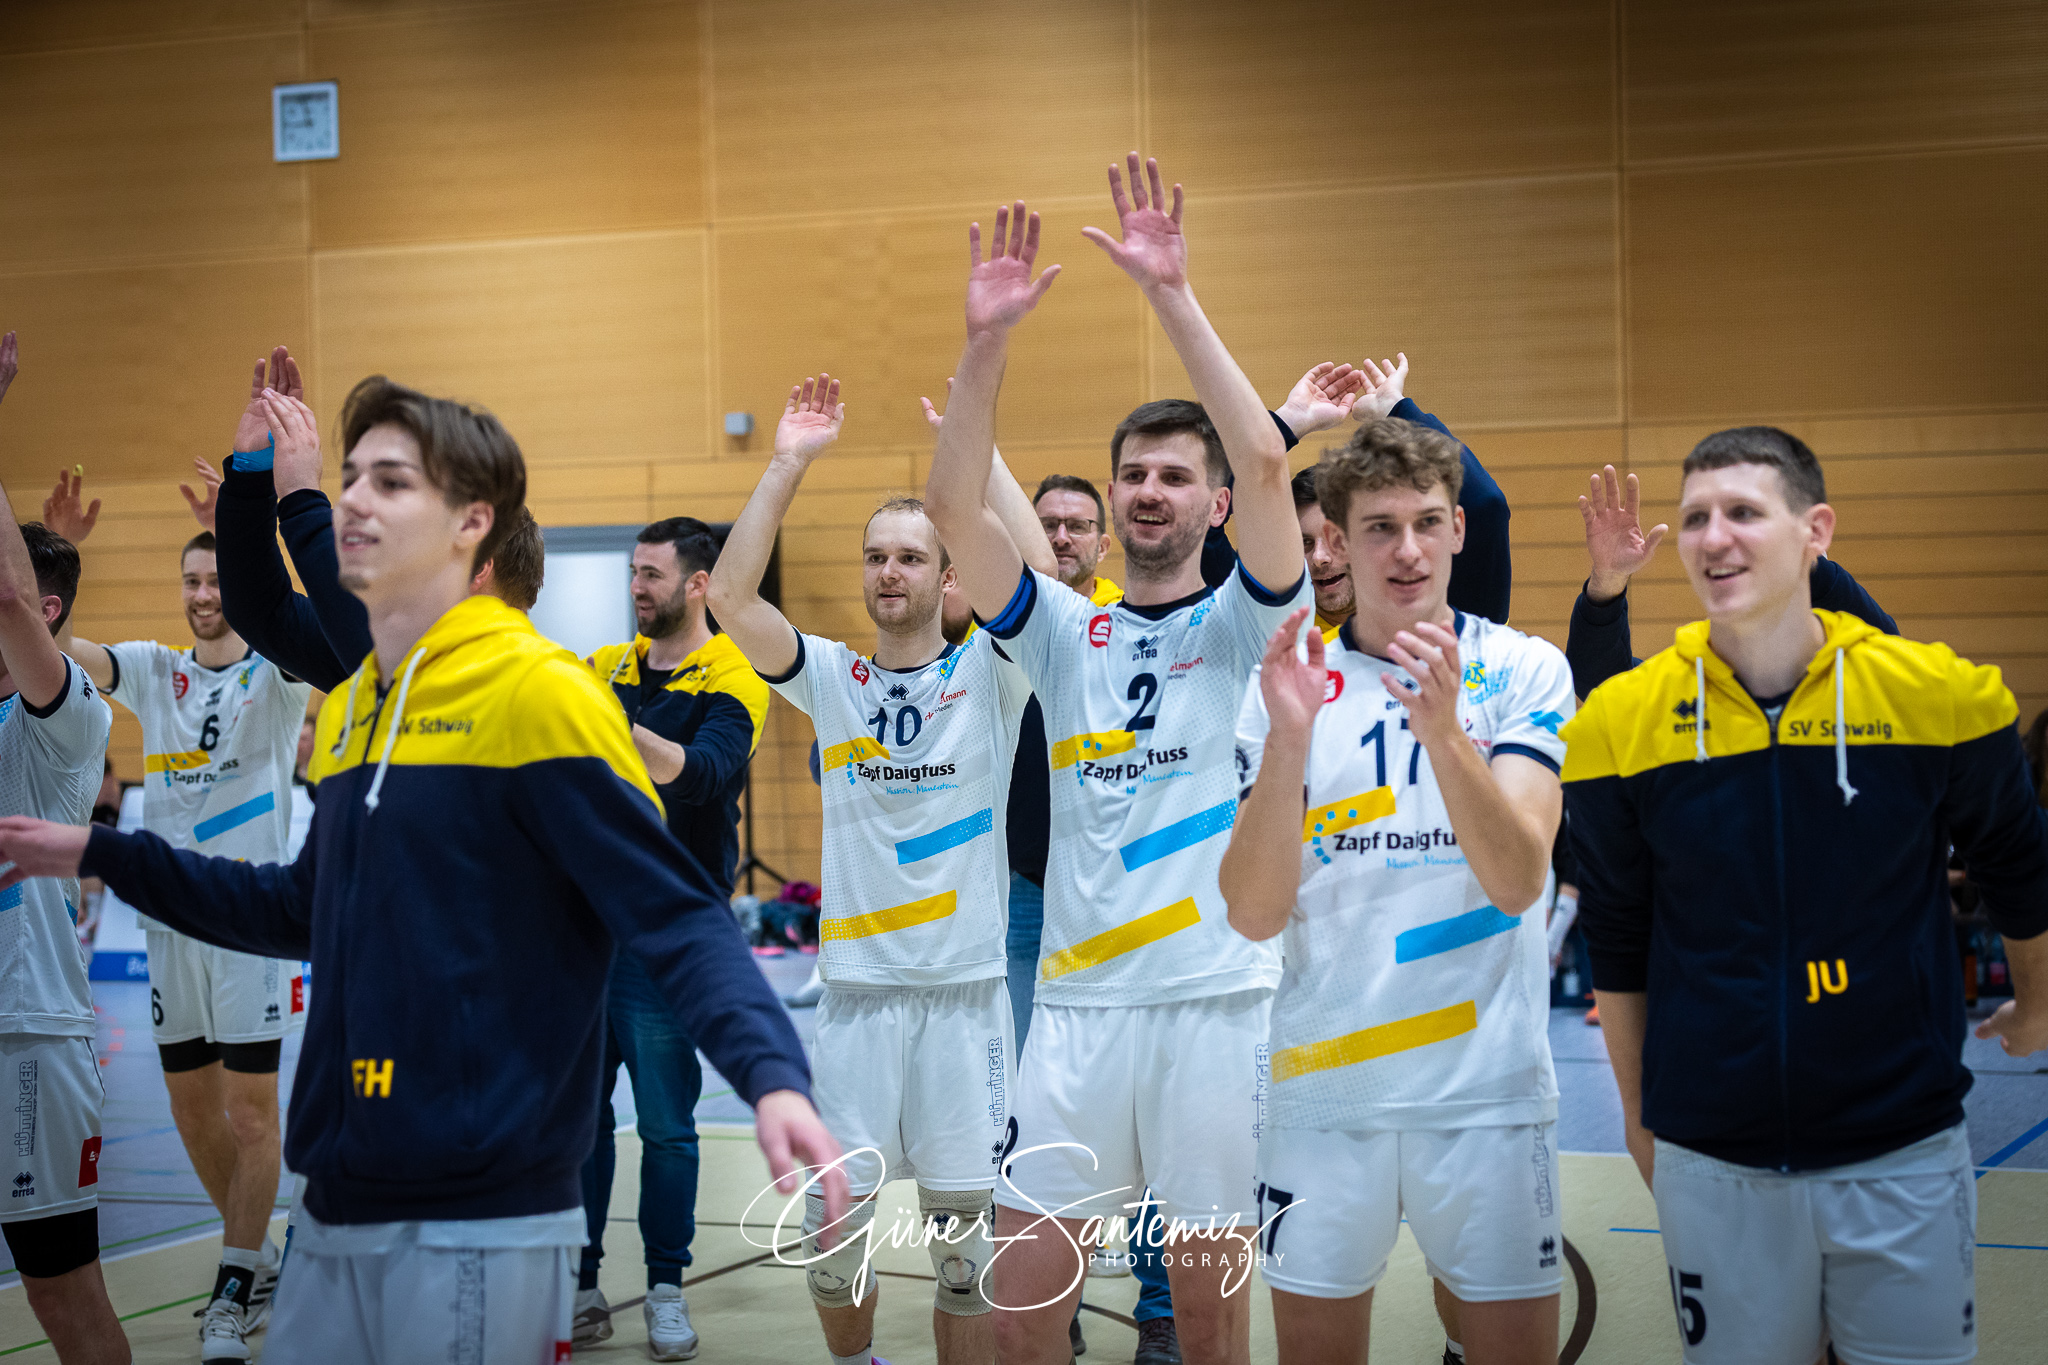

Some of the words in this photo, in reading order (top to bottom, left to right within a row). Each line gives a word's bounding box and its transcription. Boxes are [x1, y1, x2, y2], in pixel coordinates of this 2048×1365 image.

[1125, 672, 1158, 732] 2
[199, 714, 220, 751] 6
[419, 715, 473, 736] Schwaig
[868, 705, 922, 746] 10
[1674, 718, 1710, 733] erra
[1789, 720, 1812, 738] SV
[857, 762, 880, 782] Zapf
[883, 763, 956, 782] Daigfuss
[1083, 761, 1123, 782] Zapf
[1361, 718, 1422, 787] 17
[1333, 831, 1381, 854] Zapf
[1386, 828, 1458, 851] Daigfu
[1806, 958, 1849, 1004] JU
[151, 987, 164, 1026] 6
[351, 1058, 394, 1098] FH
[998, 1115, 1019, 1178] 2
[1257, 1181, 1293, 1256] 17
